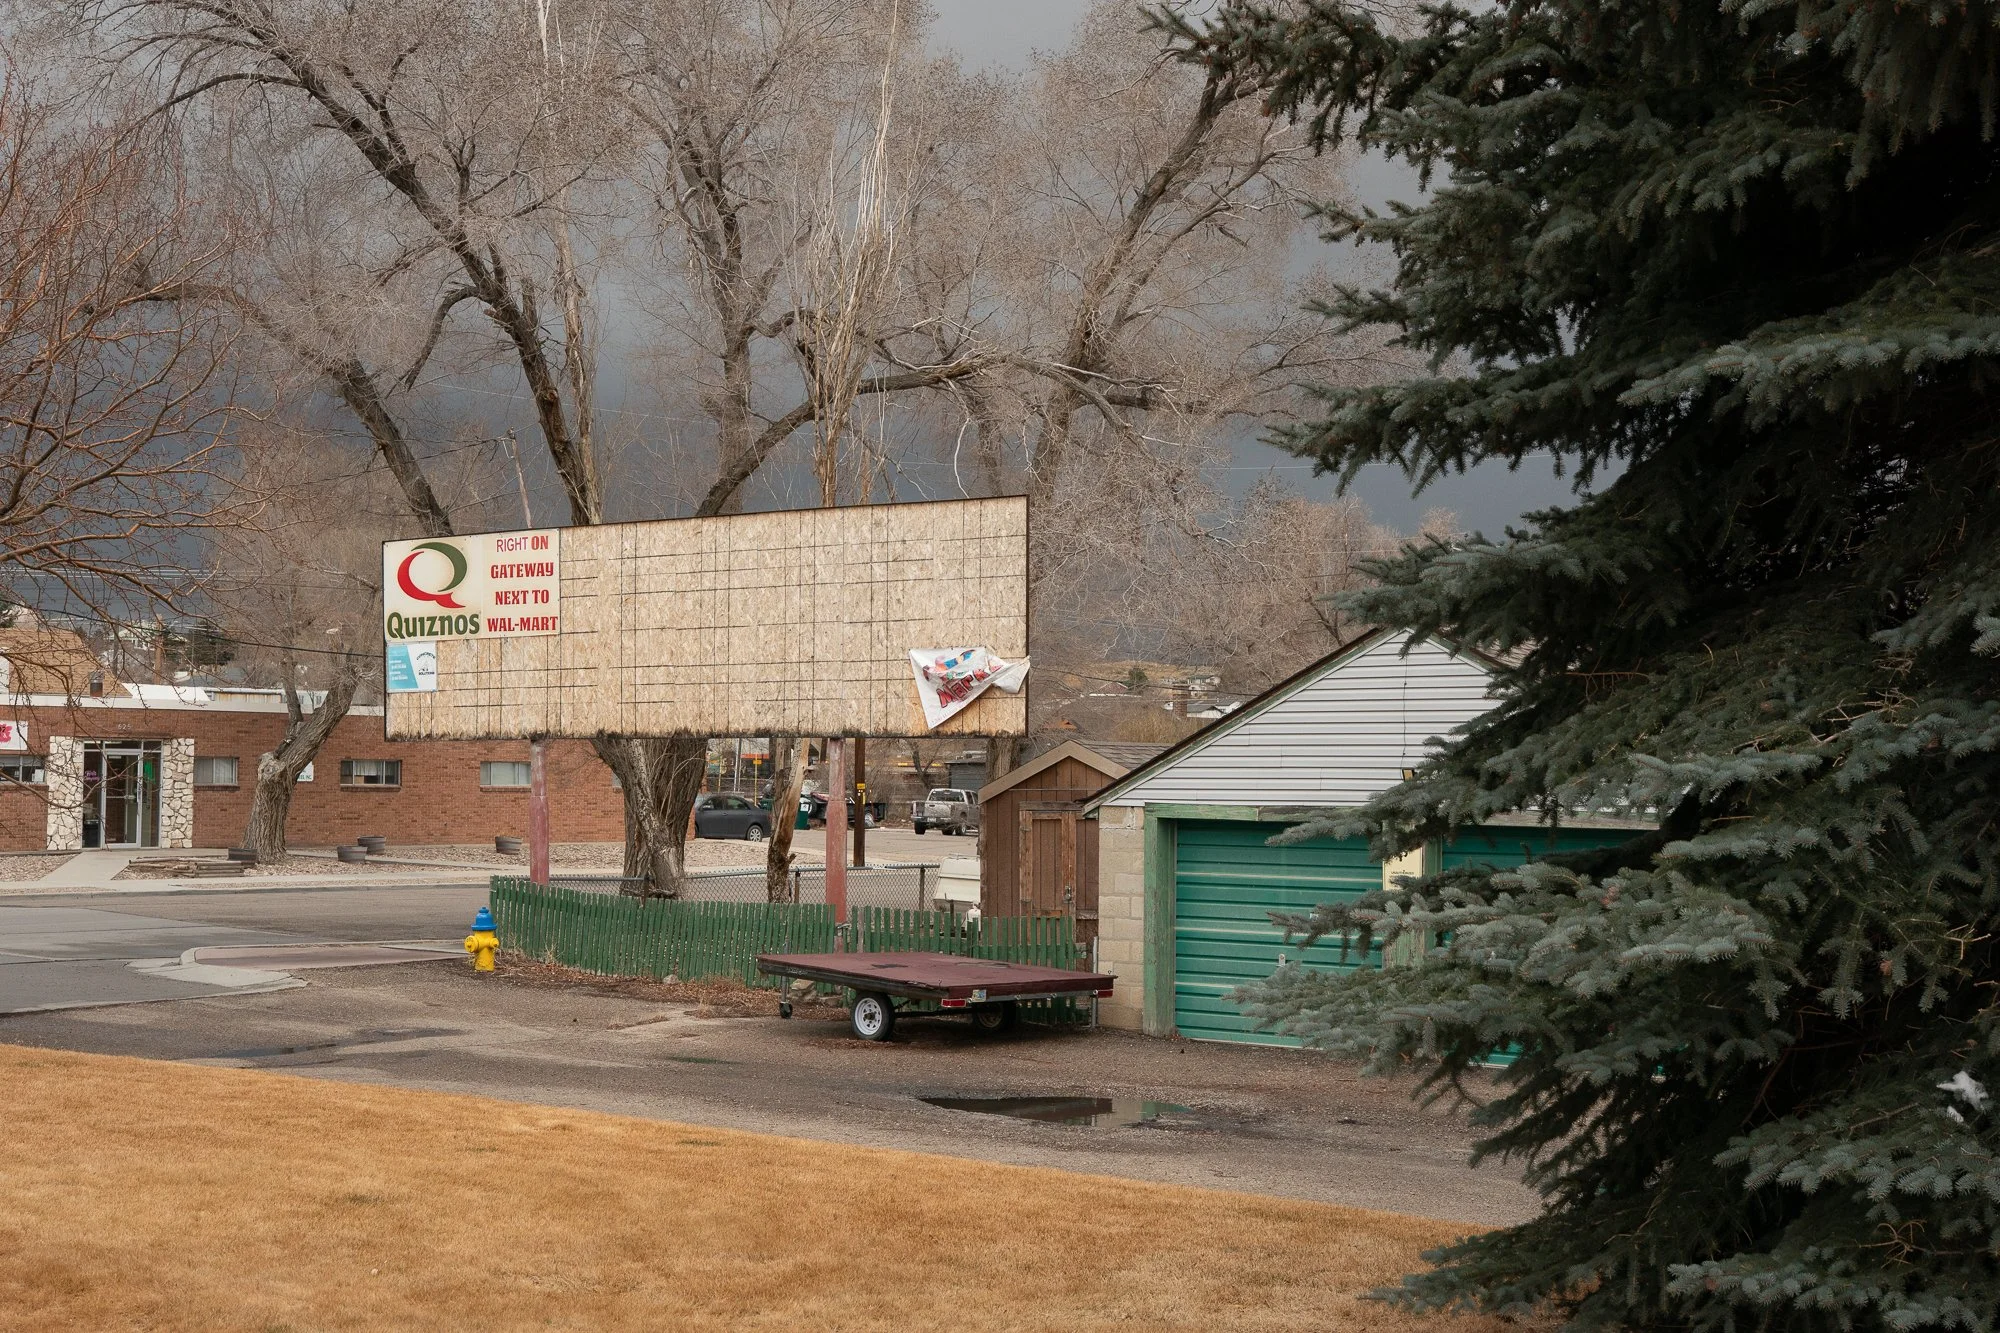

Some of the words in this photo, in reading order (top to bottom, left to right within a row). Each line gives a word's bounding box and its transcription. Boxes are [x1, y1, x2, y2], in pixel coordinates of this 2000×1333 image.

[496, 537, 528, 552] RIGHT
[531, 535, 549, 550] ON
[490, 562, 554, 579] GATEWAY
[495, 590, 528, 605] NEXT
[530, 589, 550, 604] TO
[487, 616, 558, 632] WAL-MART
